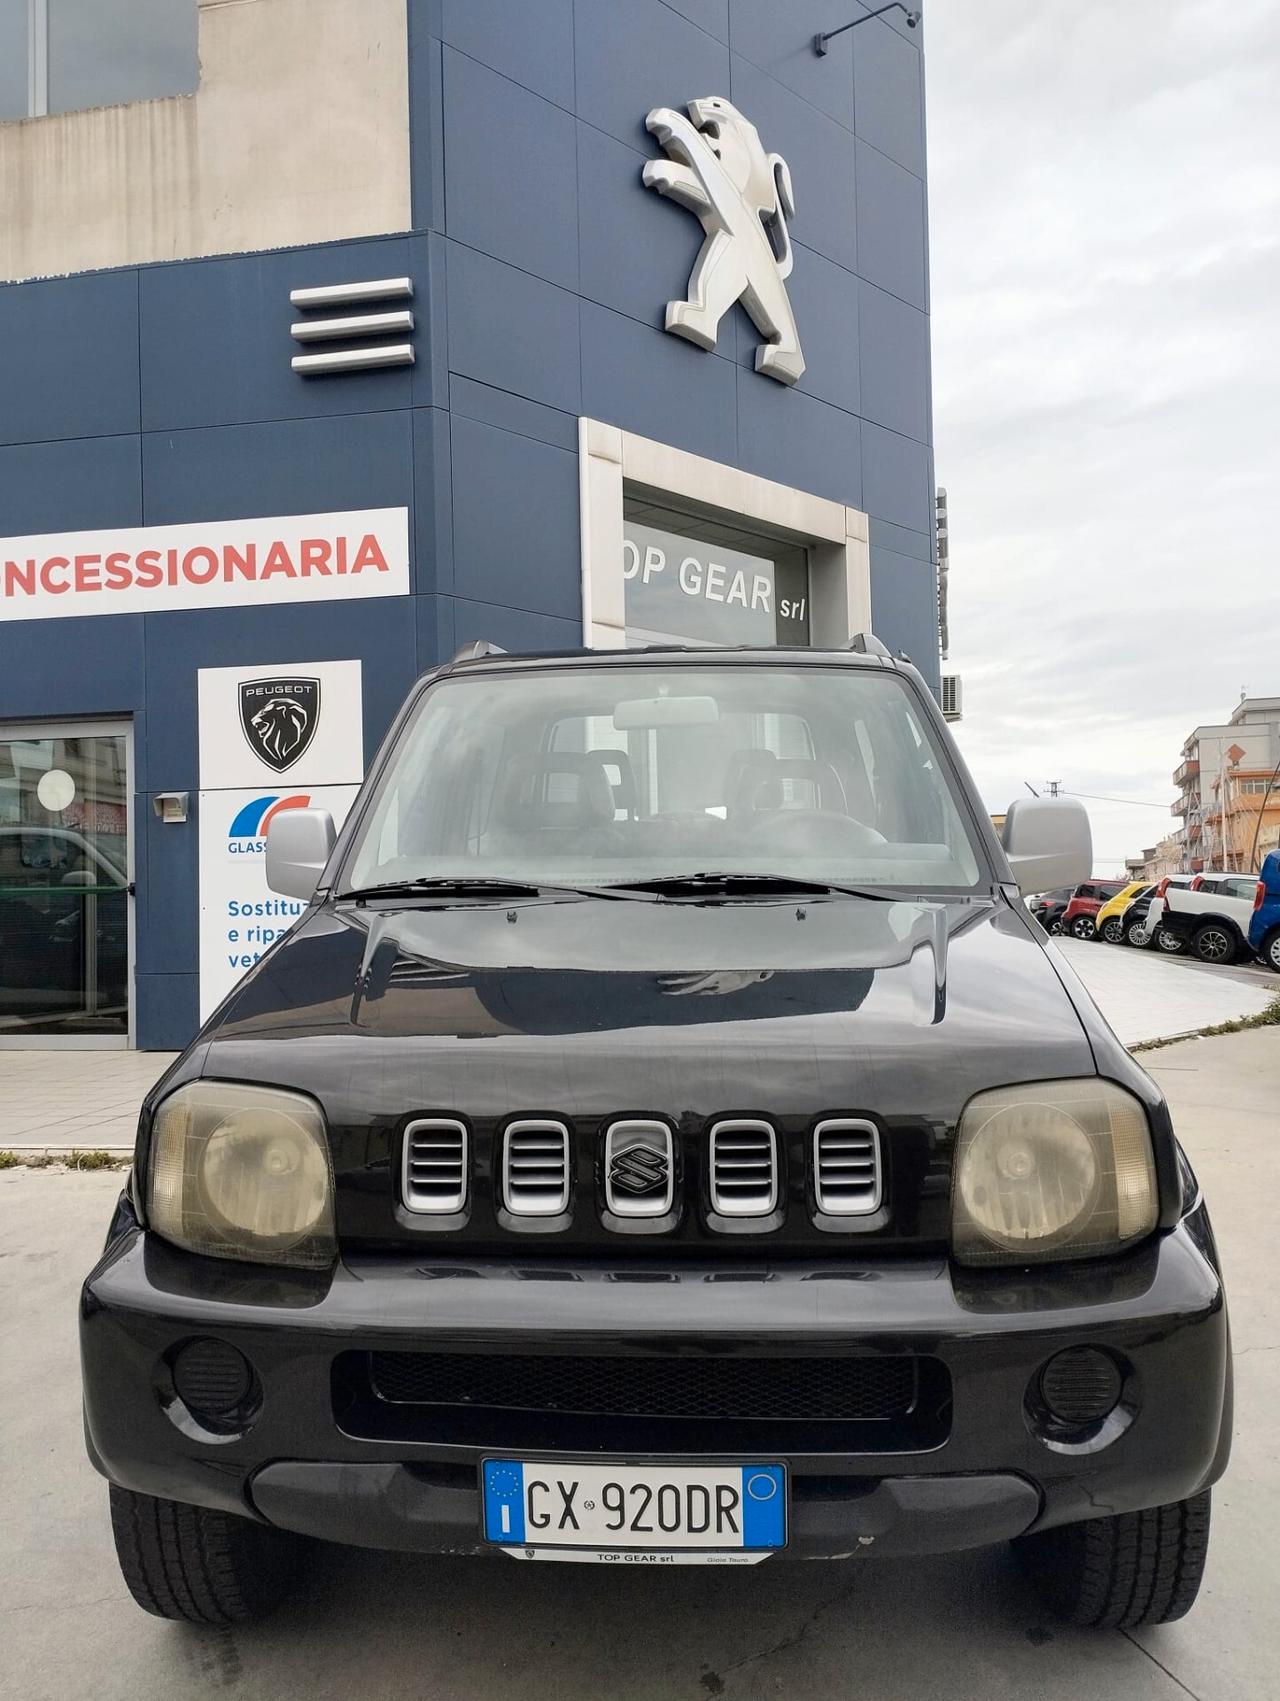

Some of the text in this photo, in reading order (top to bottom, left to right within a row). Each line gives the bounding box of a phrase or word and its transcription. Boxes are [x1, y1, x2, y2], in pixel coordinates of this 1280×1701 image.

[0, 534, 389, 597] NCESSIONARIA
[623, 540, 805, 621] OP GEAR srl
[246, 685, 313, 697] PEUGEOT
[228, 900, 309, 916] Sostitu
[227, 929, 239, 942] e
[527, 1480, 740, 1534] GX 920DR
[597, 1553, 675, 1563] TOP GEAR srl
